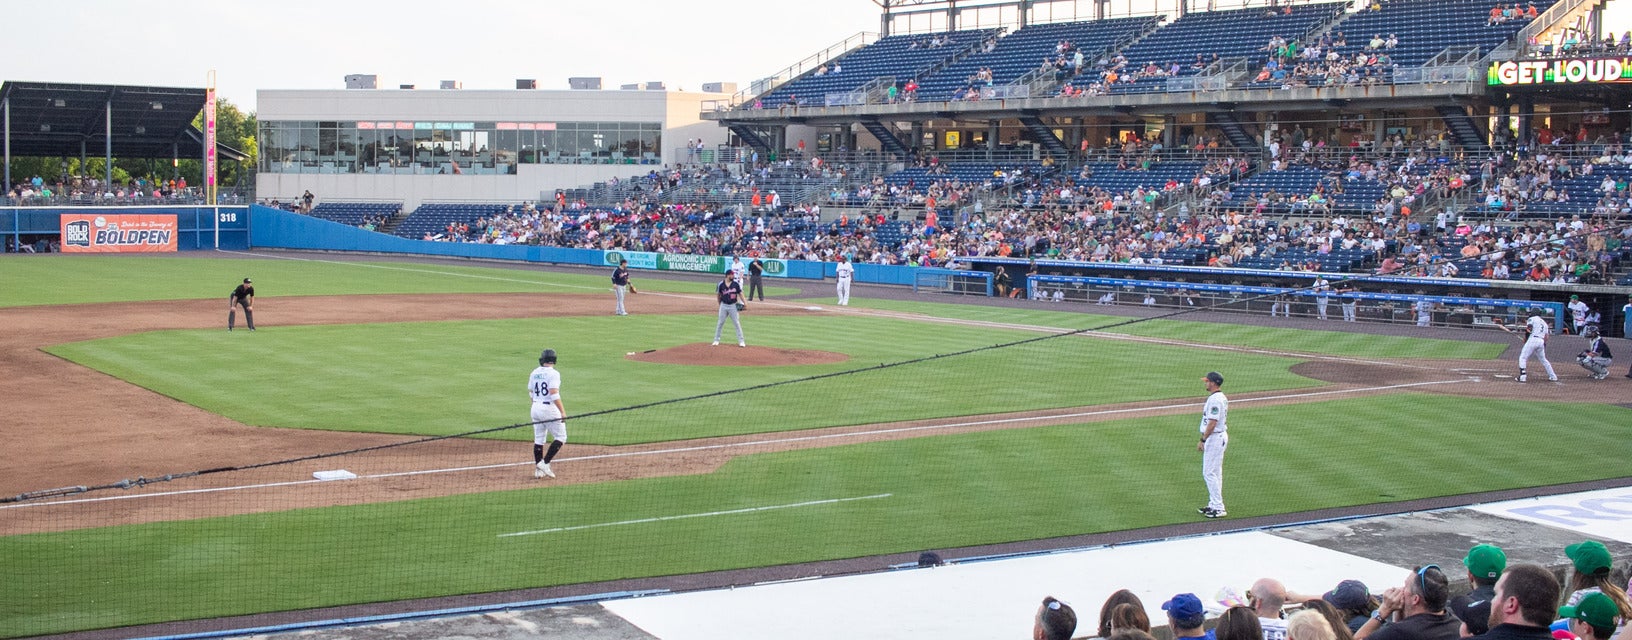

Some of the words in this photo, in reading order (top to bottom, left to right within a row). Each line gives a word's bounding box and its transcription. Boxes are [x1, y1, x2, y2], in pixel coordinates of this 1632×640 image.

[1497, 61, 1548, 85] GET
[1553, 59, 1623, 83] LOUD
[219, 213, 237, 223] 318
[67, 224, 88, 233] BOLD
[67, 232, 89, 242] ROCK
[95, 229, 171, 245] BOLDPEN
[610, 252, 620, 263] ALM
[663, 253, 699, 263] AGRONOMIC
[700, 255, 718, 265] LAWN
[669, 261, 712, 272] MANAGEMENT
[767, 261, 780, 273] ALM
[1540, 324, 1545, 333] 3
[534, 381, 549, 397] 48
